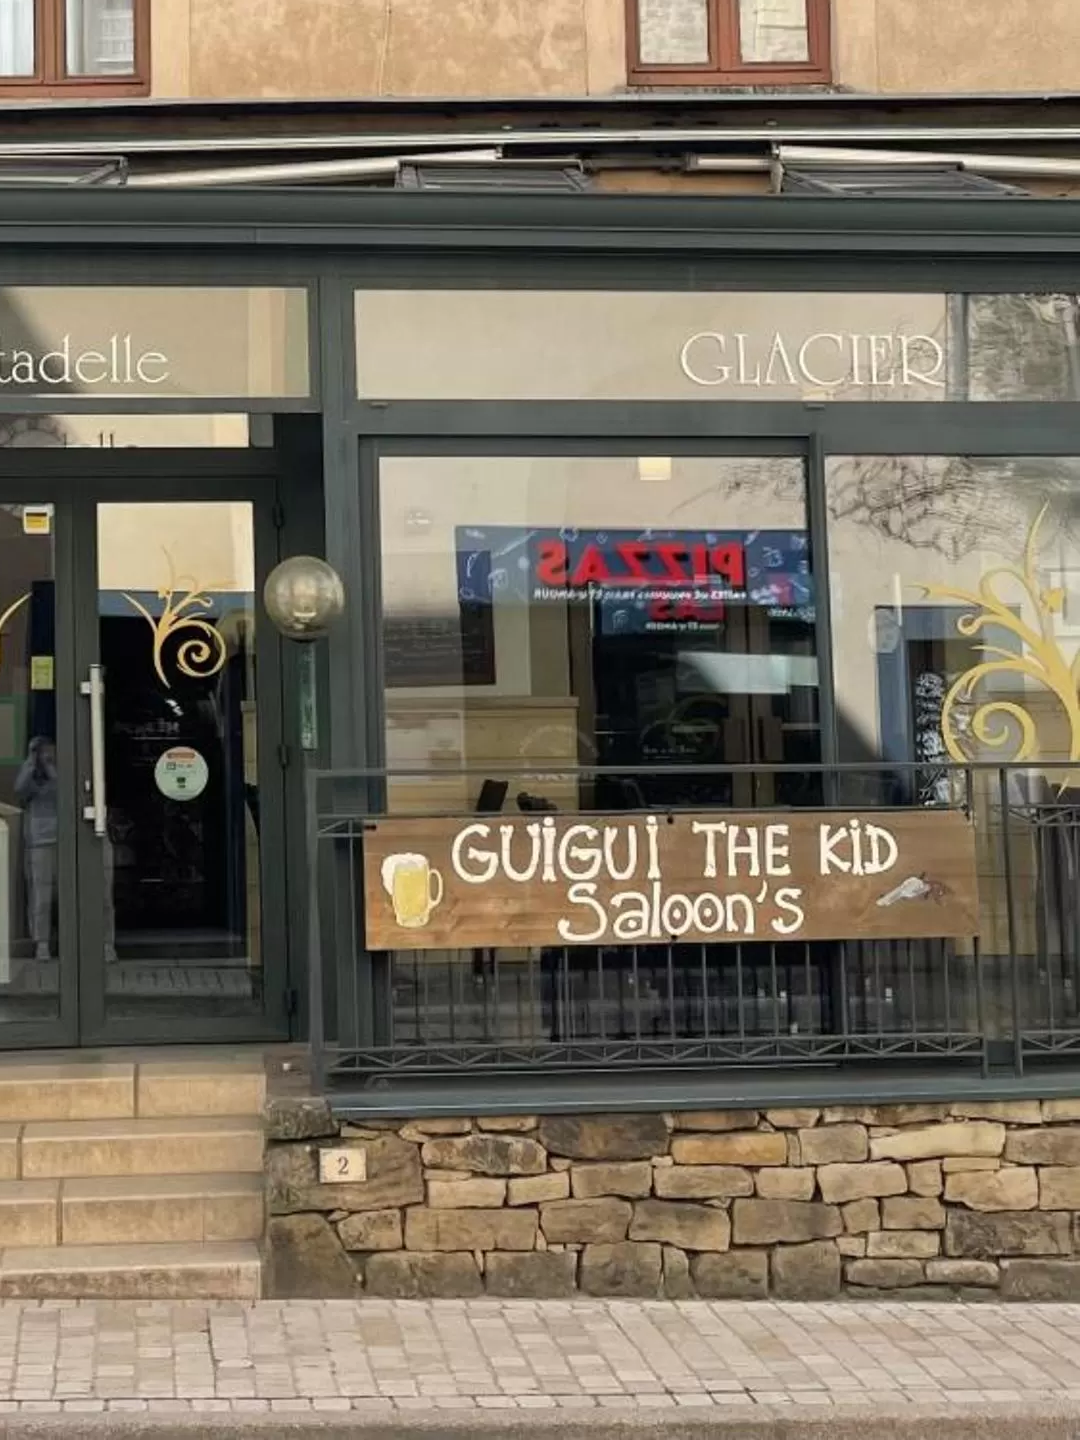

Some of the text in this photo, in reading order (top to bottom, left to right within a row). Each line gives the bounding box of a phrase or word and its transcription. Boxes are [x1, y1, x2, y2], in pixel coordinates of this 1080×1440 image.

[680, 332, 945, 388] GLACIER
[692, 821, 789, 878] THE
[558, 881, 804, 943] Saloon's
[337, 1156, 349, 1175] 2
